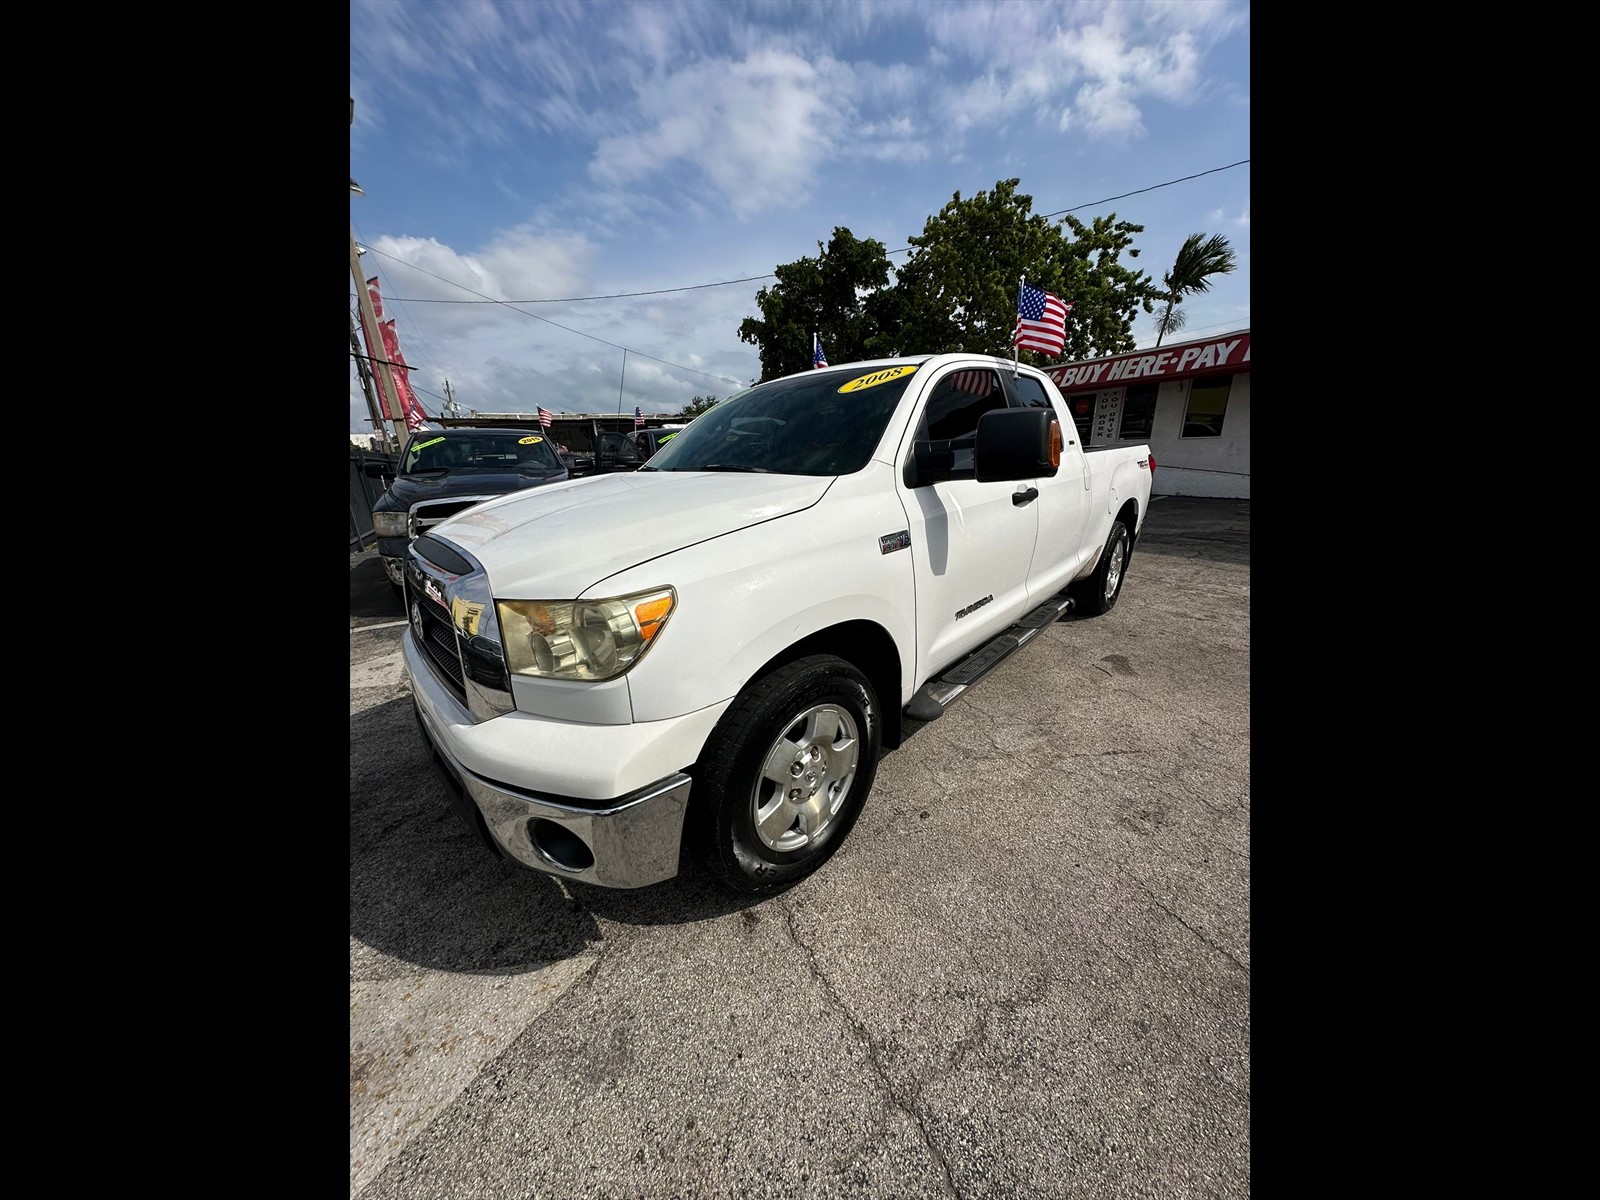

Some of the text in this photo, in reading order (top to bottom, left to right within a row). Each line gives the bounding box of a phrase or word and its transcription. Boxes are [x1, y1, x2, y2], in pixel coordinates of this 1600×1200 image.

[852, 367, 904, 390] 2008
[1059, 362, 1110, 387] BUY
[1106, 351, 1174, 381] HERE
[1176, 339, 1242, 372] PAY
[1096, 391, 1109, 437] YOU WORK
[1106, 390, 1119, 438] YOU DRIVE
